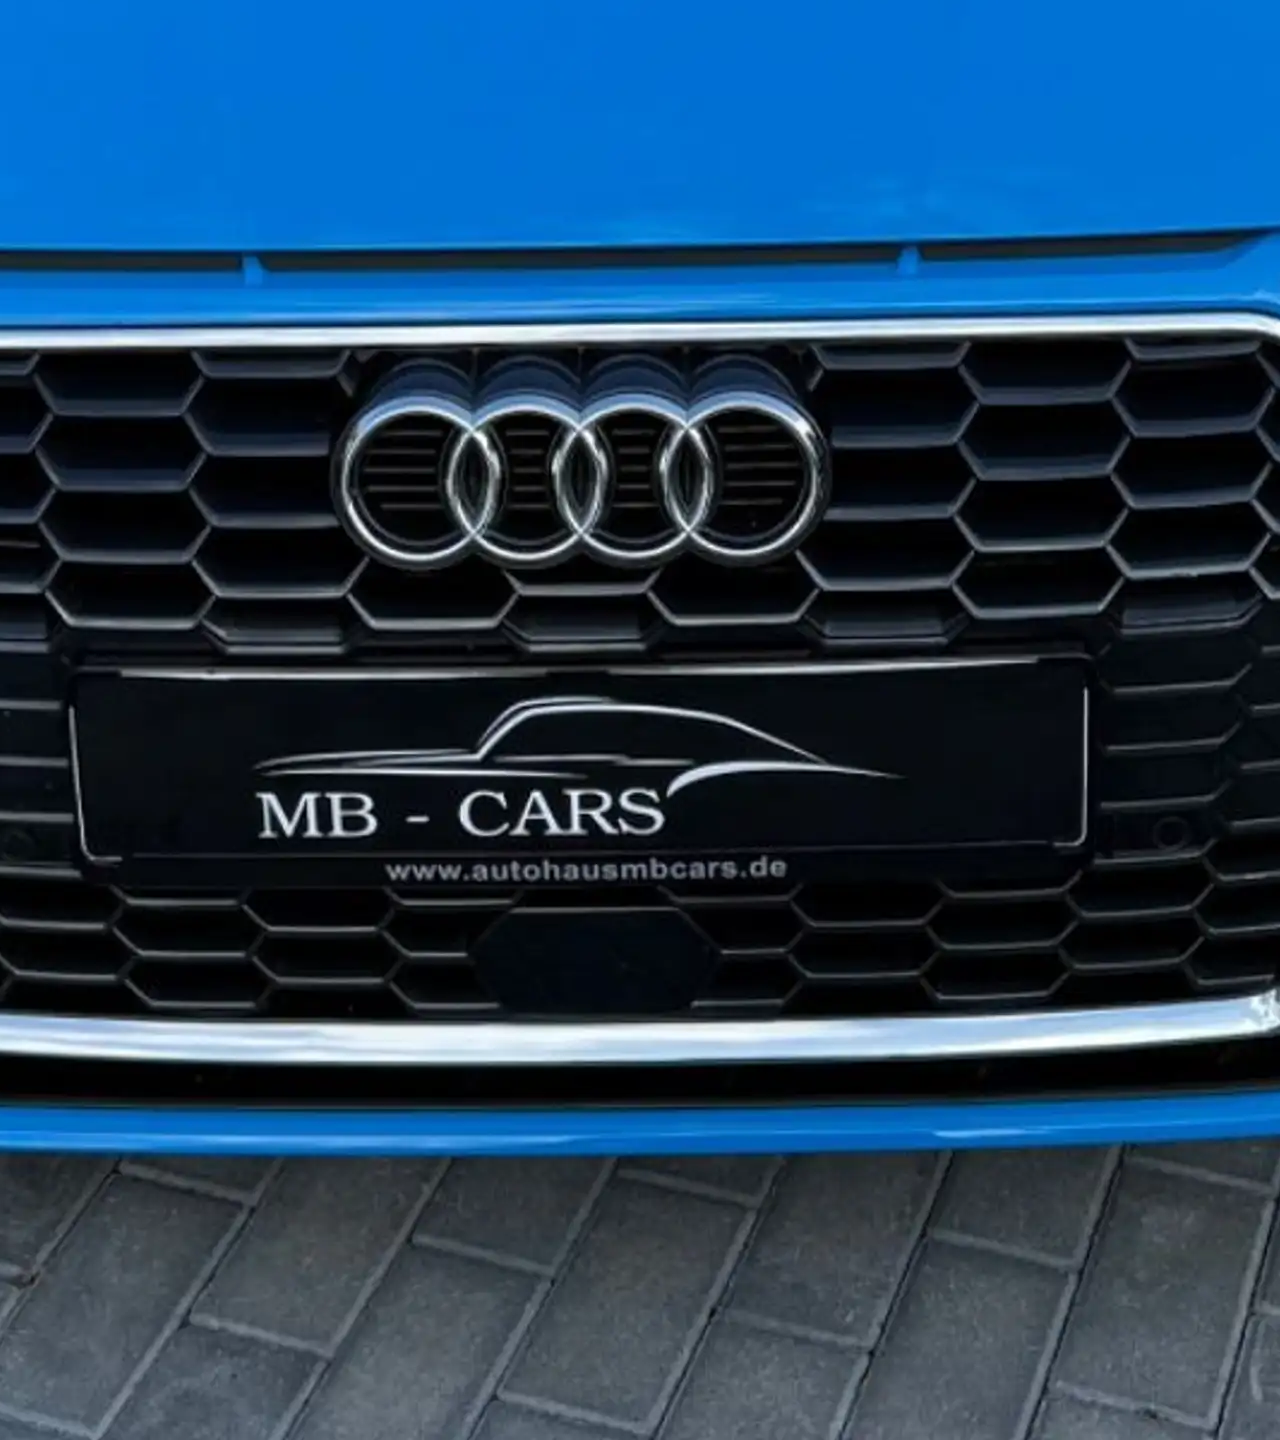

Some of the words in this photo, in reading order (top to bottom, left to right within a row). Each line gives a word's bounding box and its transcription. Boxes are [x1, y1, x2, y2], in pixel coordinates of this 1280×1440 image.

[256, 790, 378, 838] MB
[458, 788, 666, 837] CARS
[386, 856, 787, 881] www.autohausmbcars.de
